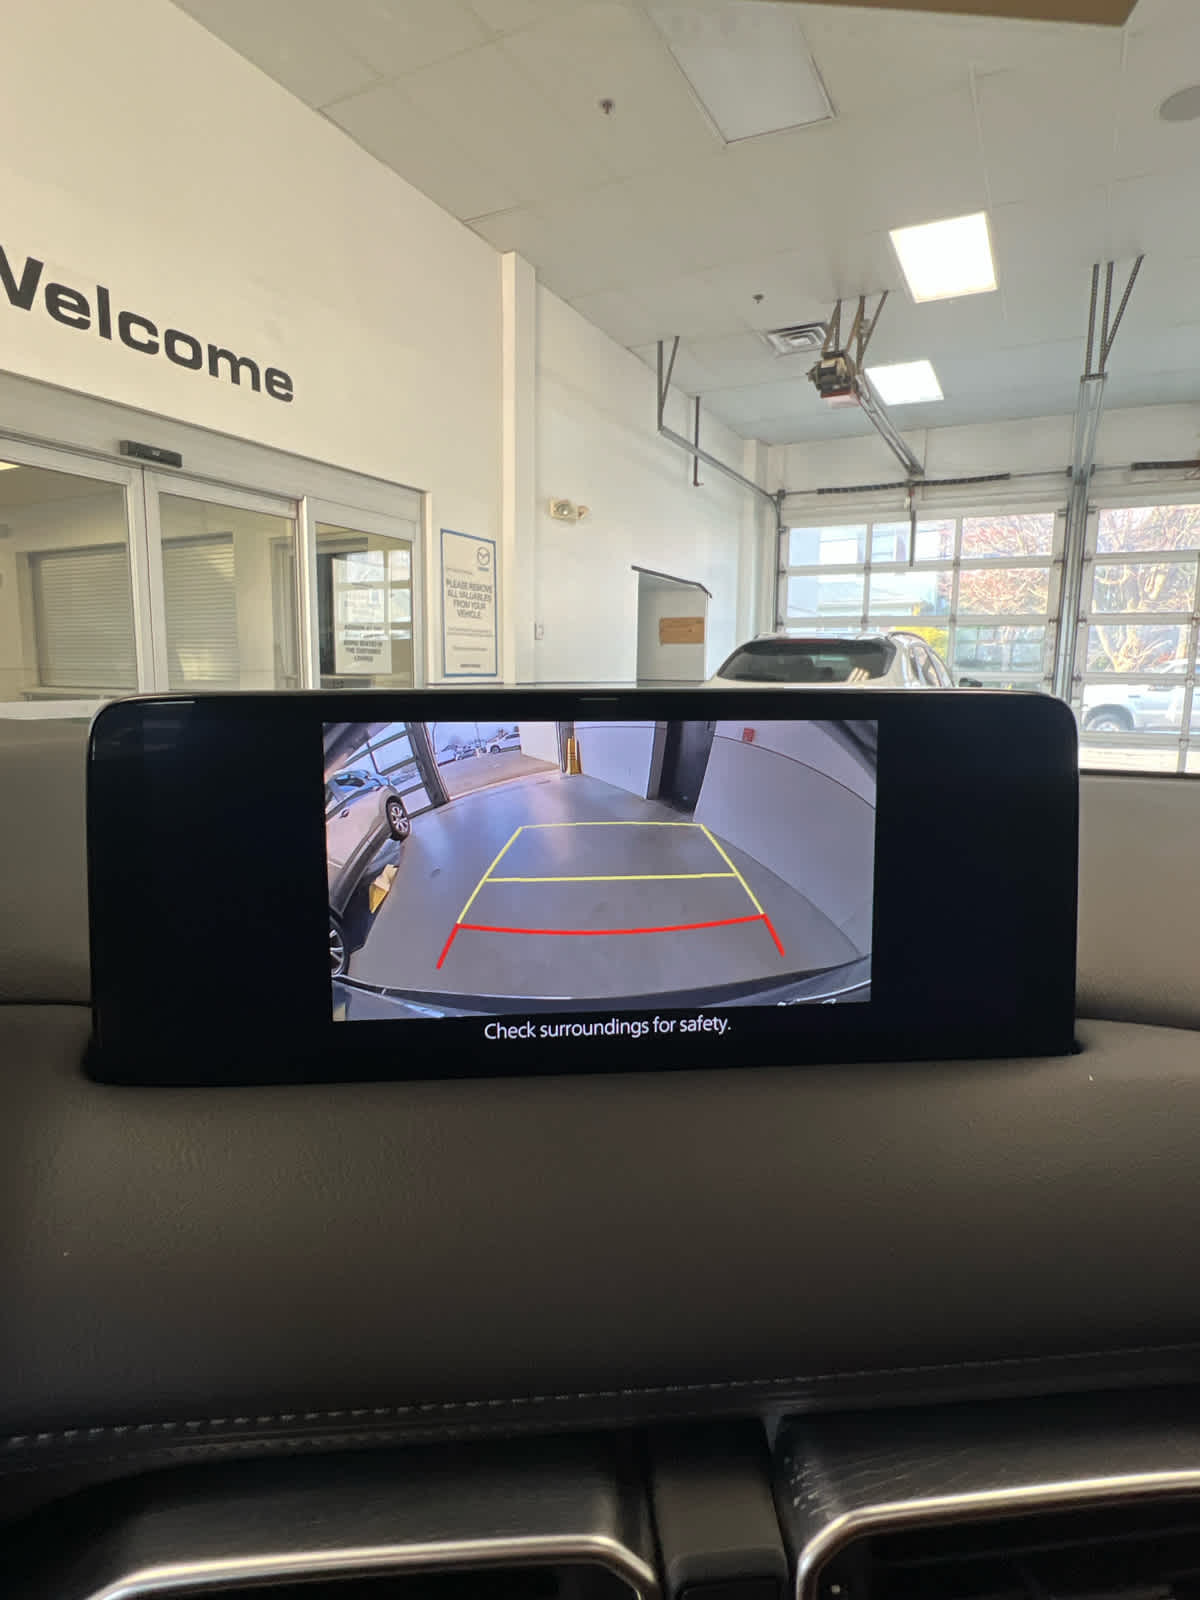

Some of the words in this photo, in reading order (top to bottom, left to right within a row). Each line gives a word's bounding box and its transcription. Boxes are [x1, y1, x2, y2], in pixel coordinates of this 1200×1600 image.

[446, 578, 468, 589] PLEASE
[469, 582, 492, 593] REMOVE
[447, 589, 459, 598] ALL
[460, 589, 492, 602] VALUABLES
[453, 600, 470, 608] FROM
[470, 601, 486, 610] YOUR
[457, 609, 481, 619] VEHICLE
[484, 1021, 536, 1040] Check
[539, 1017, 649, 1038] surroundings
[652, 1016, 677, 1033] for
[679, 1014, 732, 1035] safety.
